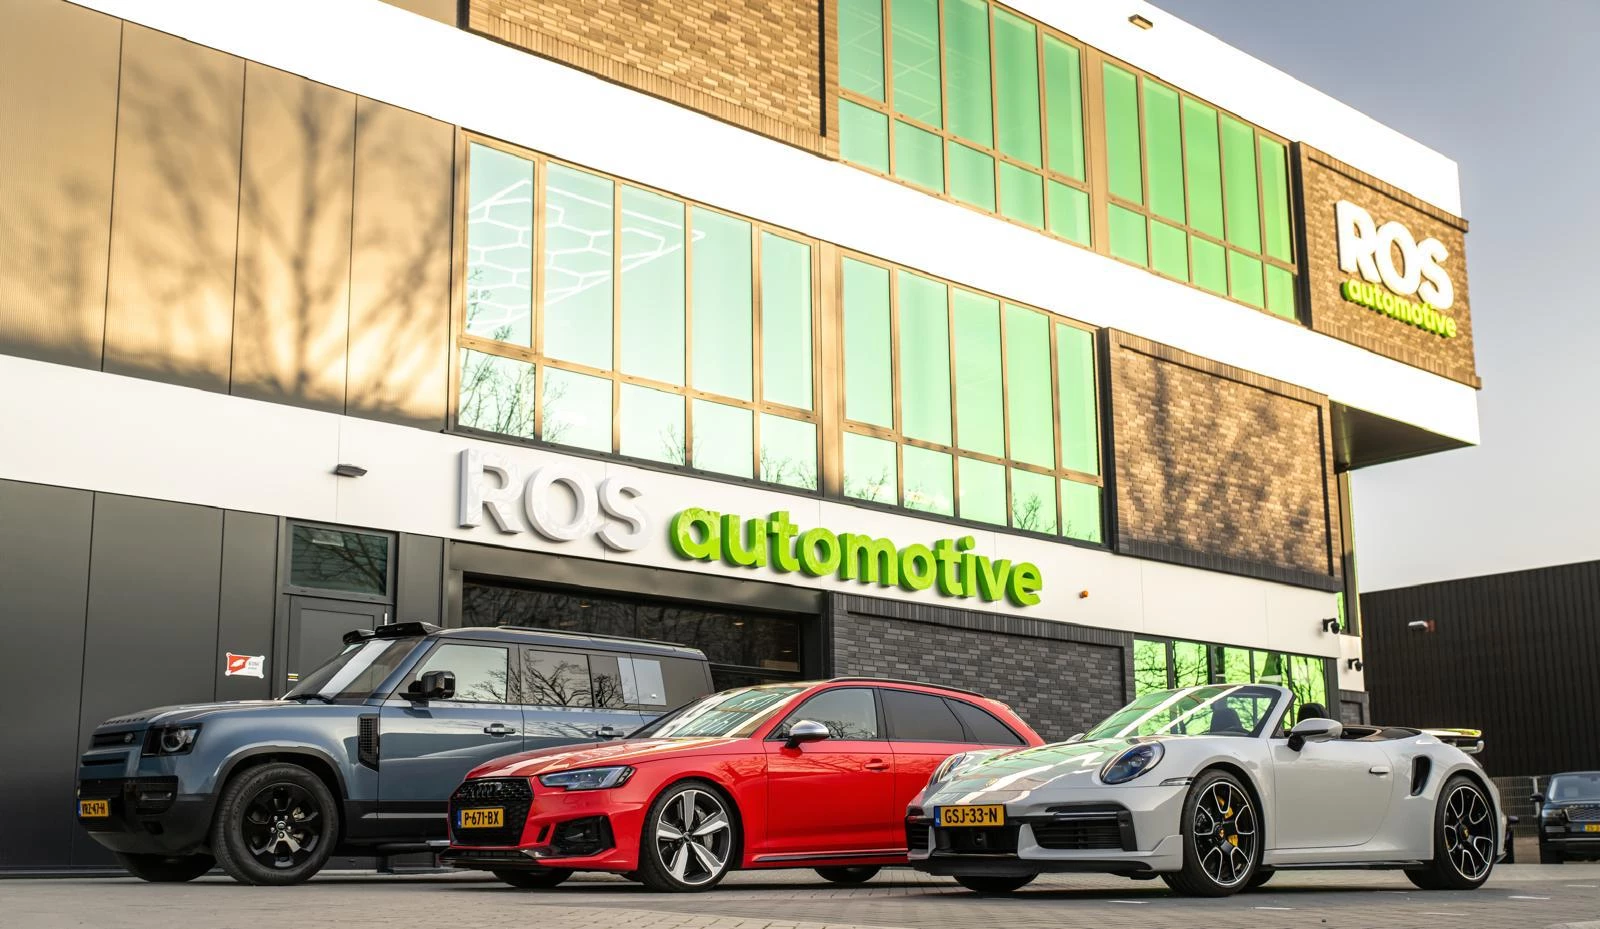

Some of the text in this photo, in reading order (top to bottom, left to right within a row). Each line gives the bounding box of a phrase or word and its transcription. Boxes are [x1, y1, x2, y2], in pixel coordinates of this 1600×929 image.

[1334, 199, 1454, 310] ROS
[1341, 279, 1457, 338] automotive
[458, 448, 1043, 607] ROS automotive
[464, 810, 499, 826] P-671-BX
[944, 807, 998, 824] GSJ-33-N
